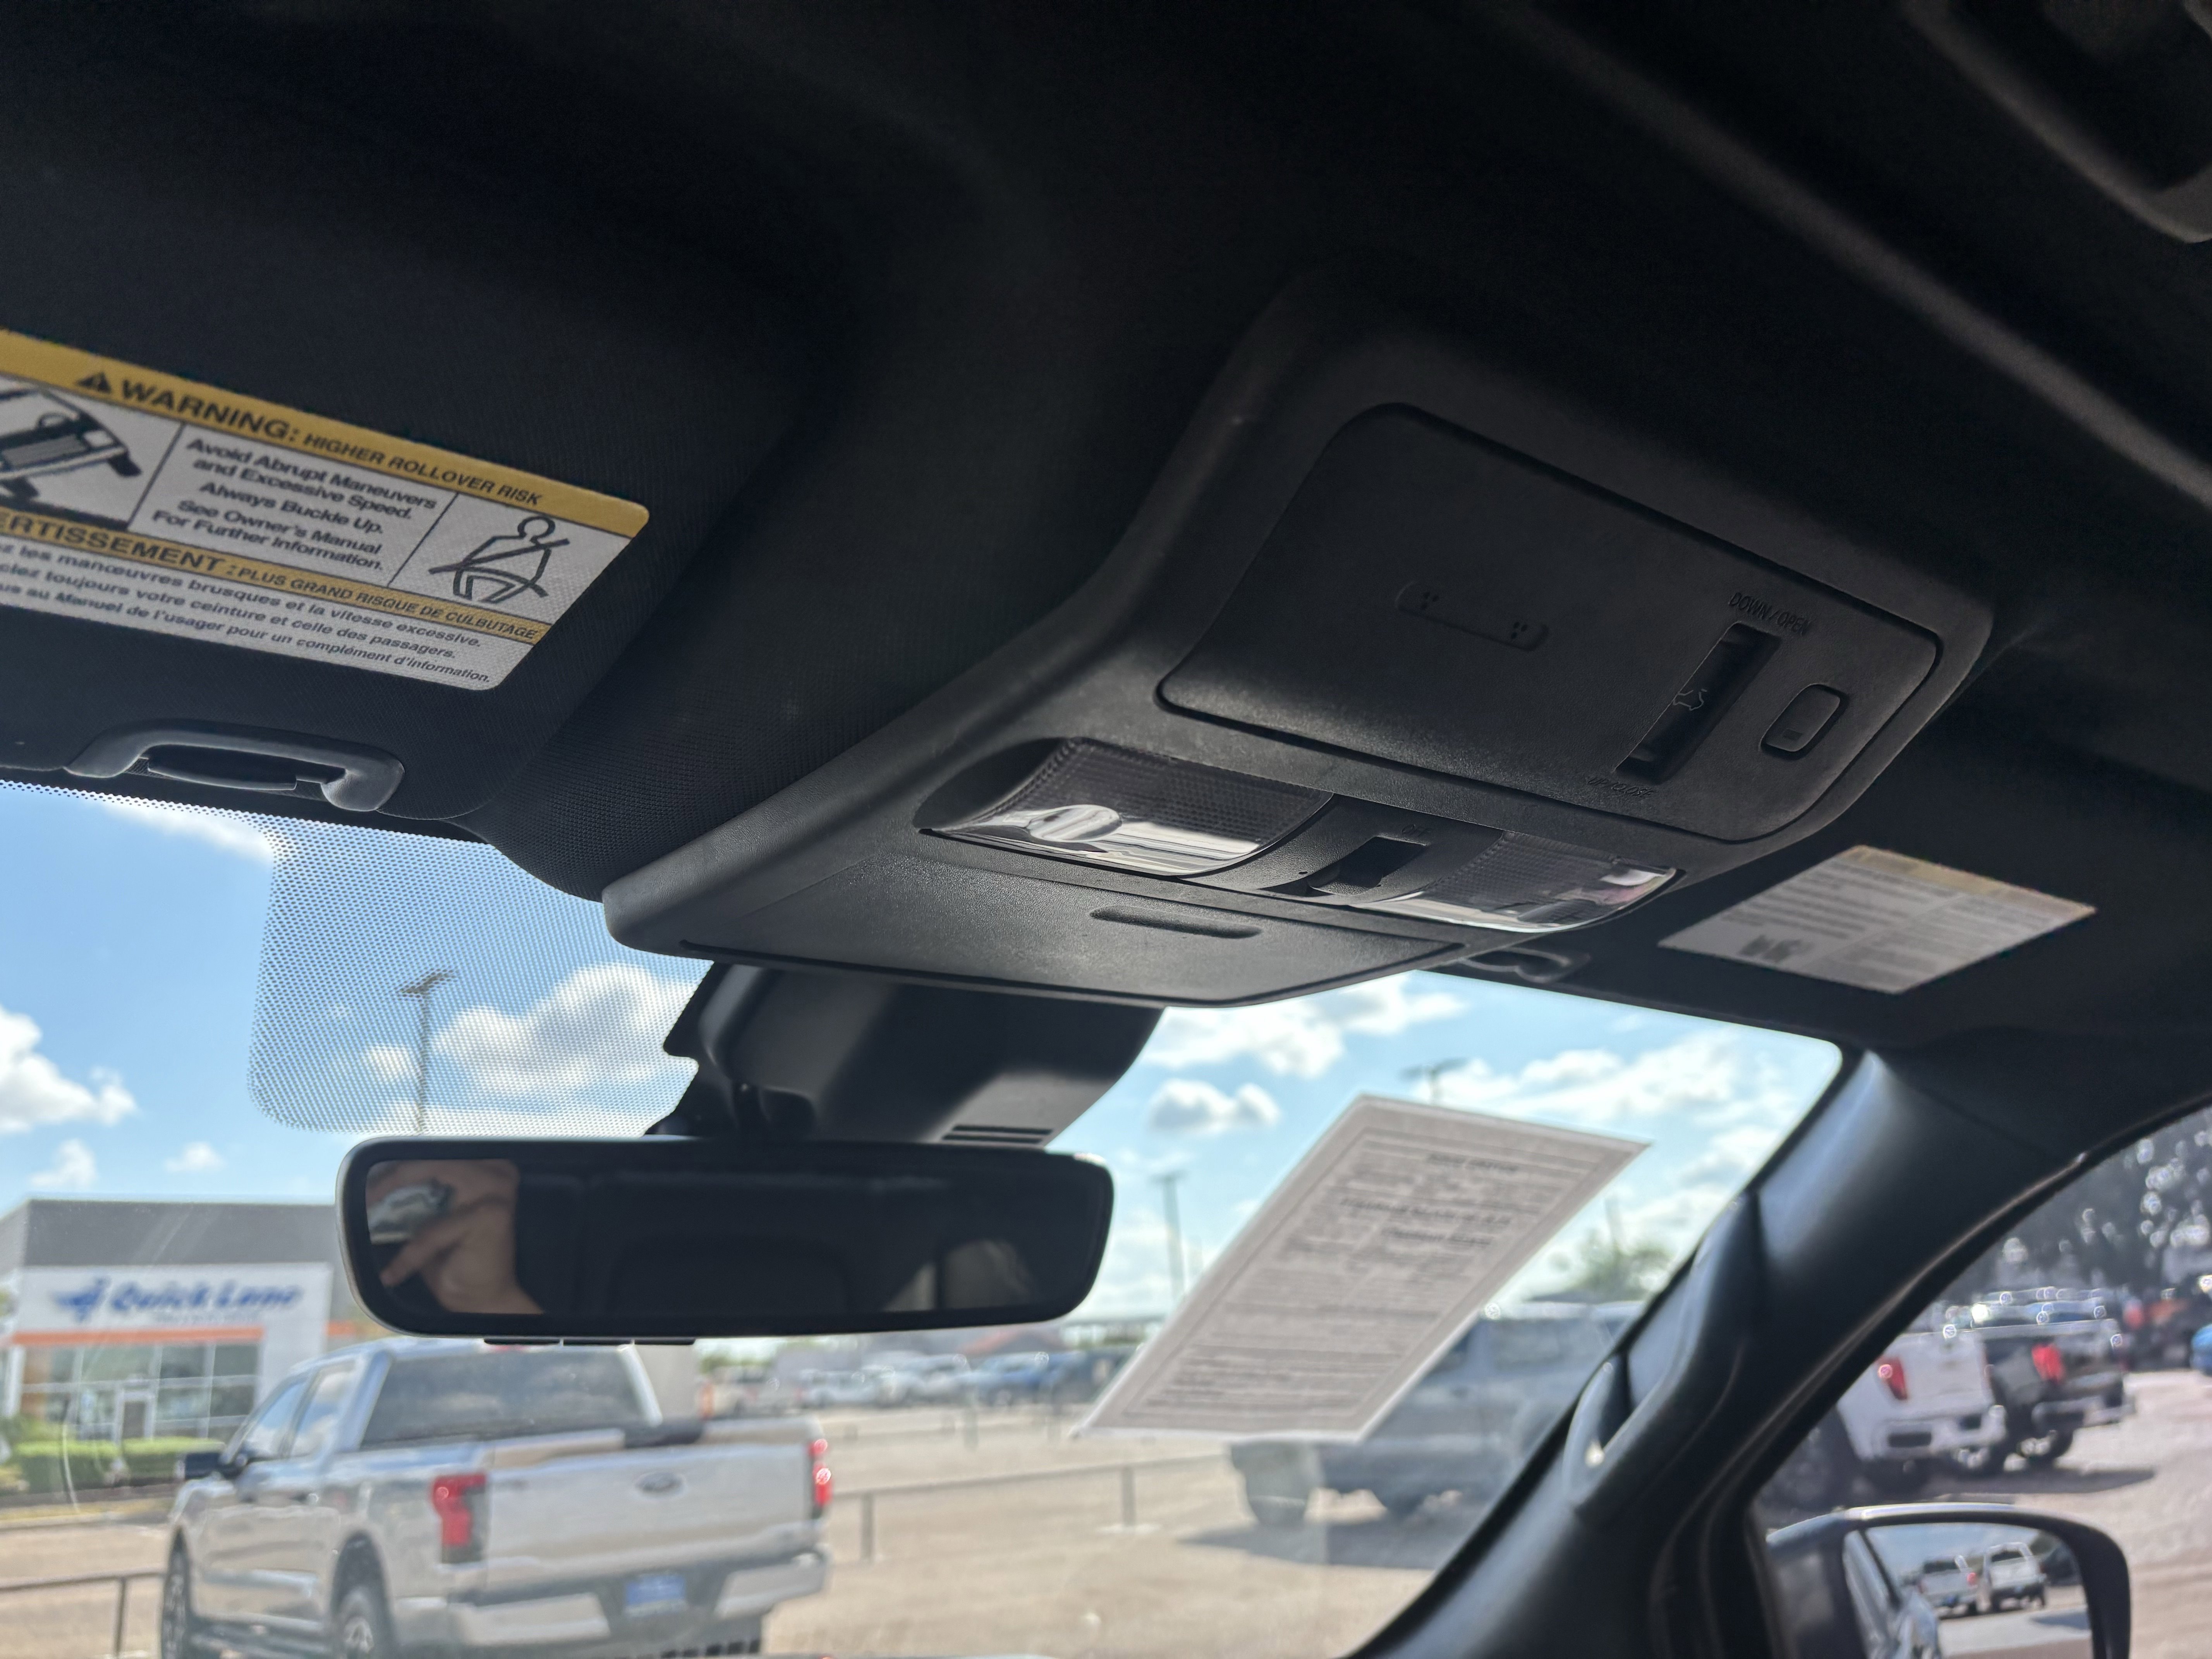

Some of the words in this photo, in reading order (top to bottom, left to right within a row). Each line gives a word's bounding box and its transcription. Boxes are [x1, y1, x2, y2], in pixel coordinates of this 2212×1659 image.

[122, 380, 299, 441] WARNING:
[303, 433, 386, 464] HIGHER
[388, 456, 494, 494] ROLLOVER
[498, 484, 543, 506] RISK
[186, 439, 253, 462] Avoid
[254, 455, 328, 485] Abrupt
[330, 473, 438, 510] Maneuvers
[194, 459, 237, 477] and
[240, 467, 345, 503] Excessive
[348, 494, 412, 520] Speed.
[199, 481, 276, 509] Always
[281, 500, 350, 526] Buckle
[353, 517, 384, 534] Up.
[153, 510, 191, 527] For
[193, 519, 270, 546] Further
[272, 537, 384, 572] Information.
[177, 500, 220, 518] See
[312, 530, 383, 555] Manual
[20, 545, 51, 561] les
[187, 580, 282, 606] brusques
[285, 600, 306, 612] et
[308, 605, 326, 615] la
[330, 610, 393, 629] vitesse
[396, 623, 481, 647] excessive.
[45, 571, 130, 595] toujours
[136, 589, 186, 606] votre
[190, 599, 266, 621] ceinture
[270, 615, 289, 627] et
[292, 620, 333, 634] celle
[336, 628, 368, 641] des
[369, 635, 456, 658] passagers.
[55, 592, 124, 613] Manuel
[126, 606, 150, 617] de
[226, 625, 269, 639] pour
[271, 633, 293, 644] un
[237, 567, 287, 586] PLUS
[290, 579, 354, 600] GRAND
[355, 592, 420, 613] RISQUE
[419, 606, 445, 617] DE
[446, 612, 539, 639] CULBUTAGE
